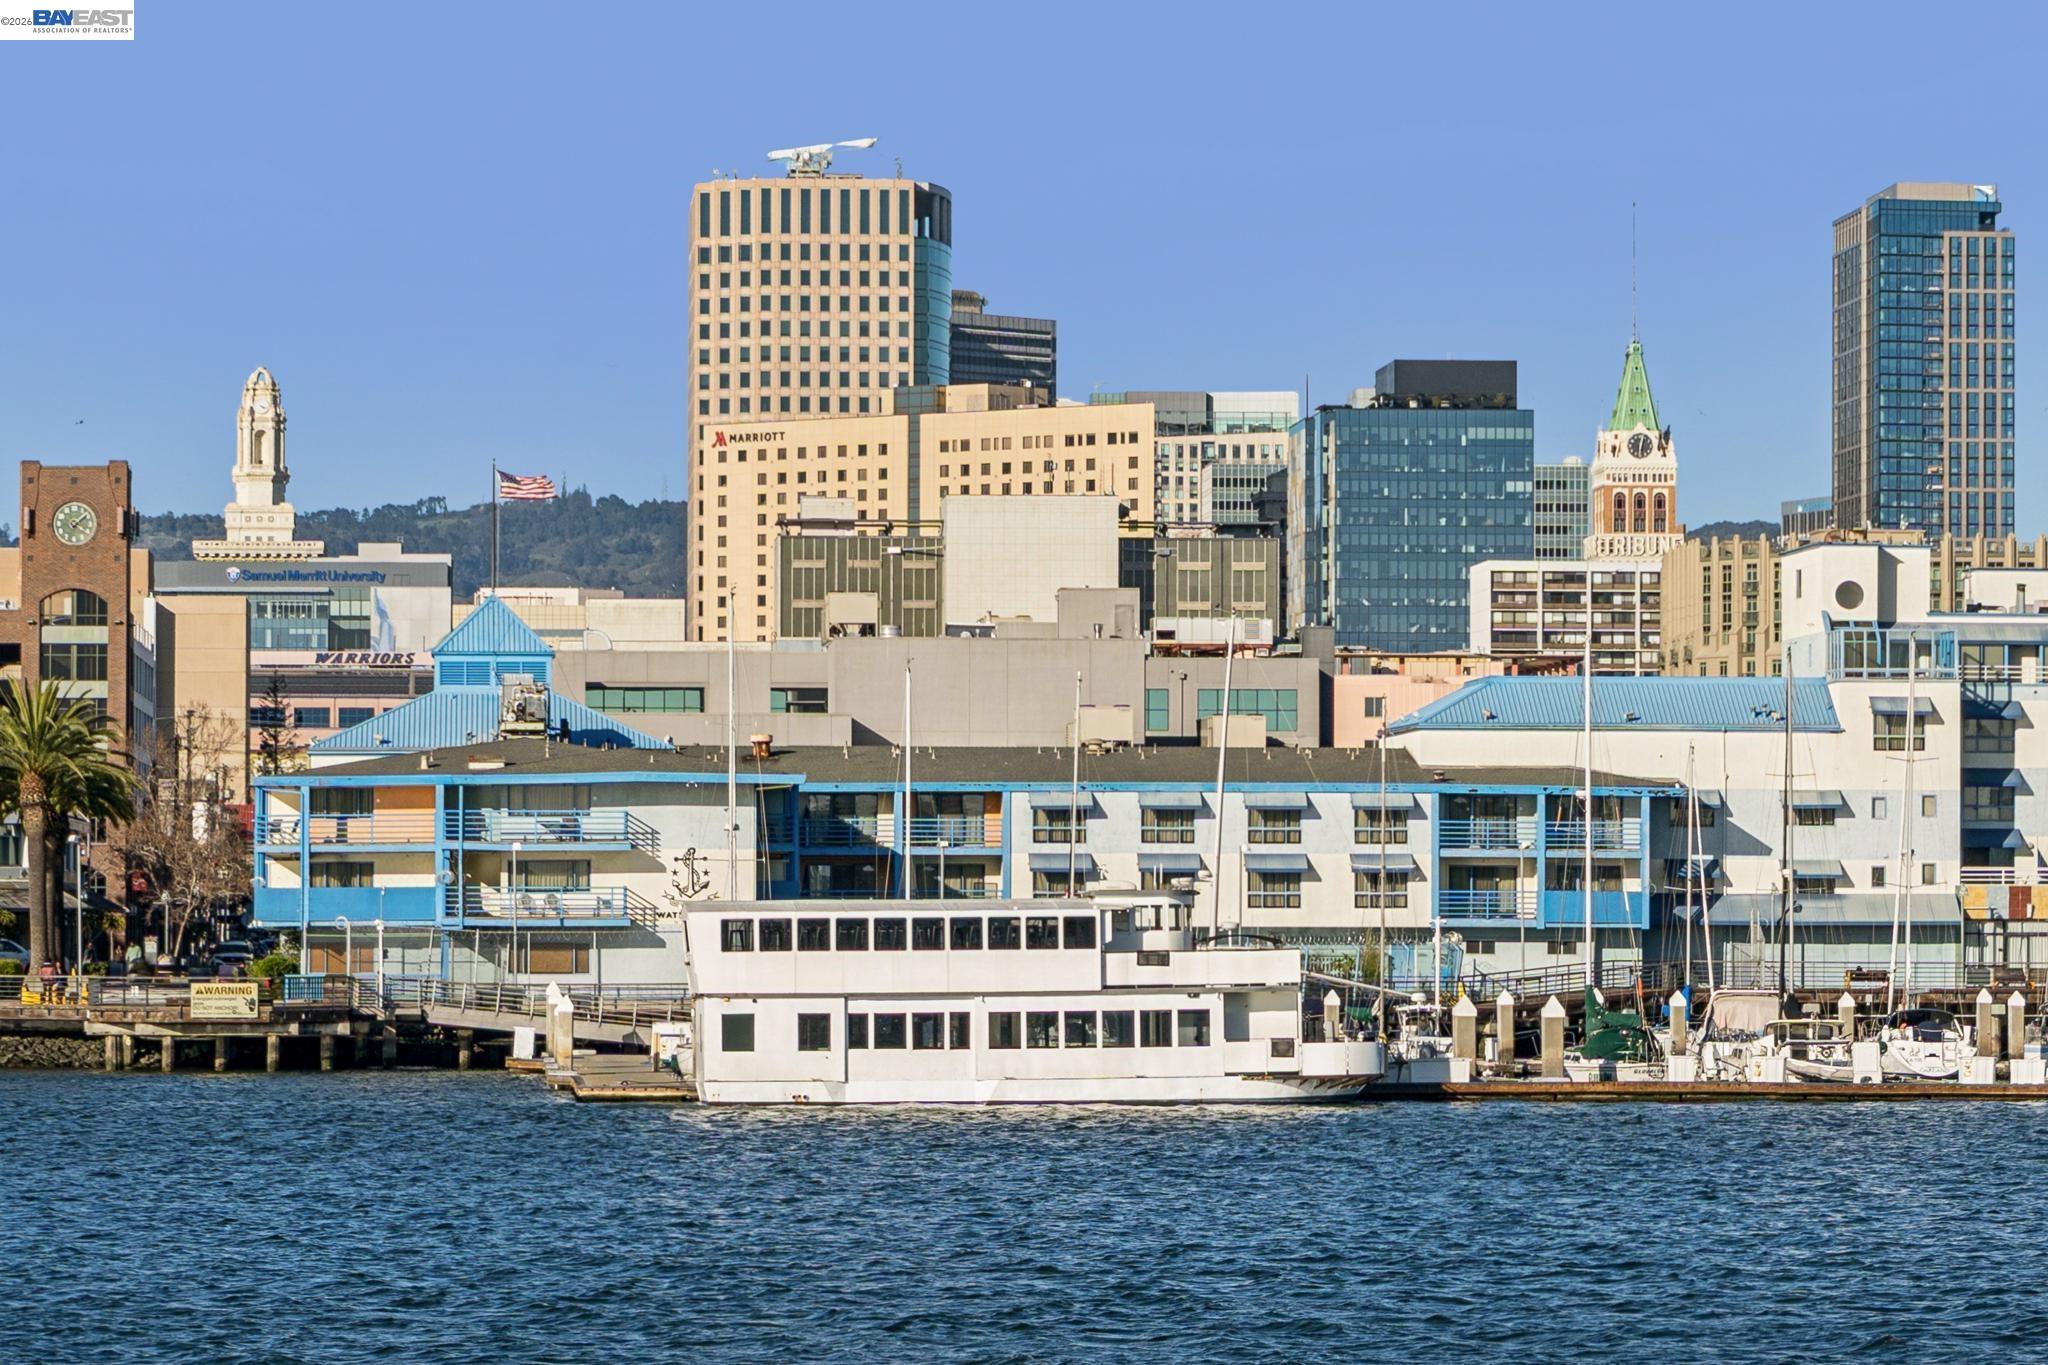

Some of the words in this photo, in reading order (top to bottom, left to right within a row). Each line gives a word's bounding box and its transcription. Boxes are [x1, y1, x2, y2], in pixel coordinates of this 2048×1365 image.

[729, 432, 786, 443] MARRIOTT
[242, 569, 287, 582] Samuel
[288, 570, 328, 582] Merritt
[328, 570, 387, 584] University
[315, 653, 416, 665] WARRIORS
[203, 986, 253, 995] WARNING
